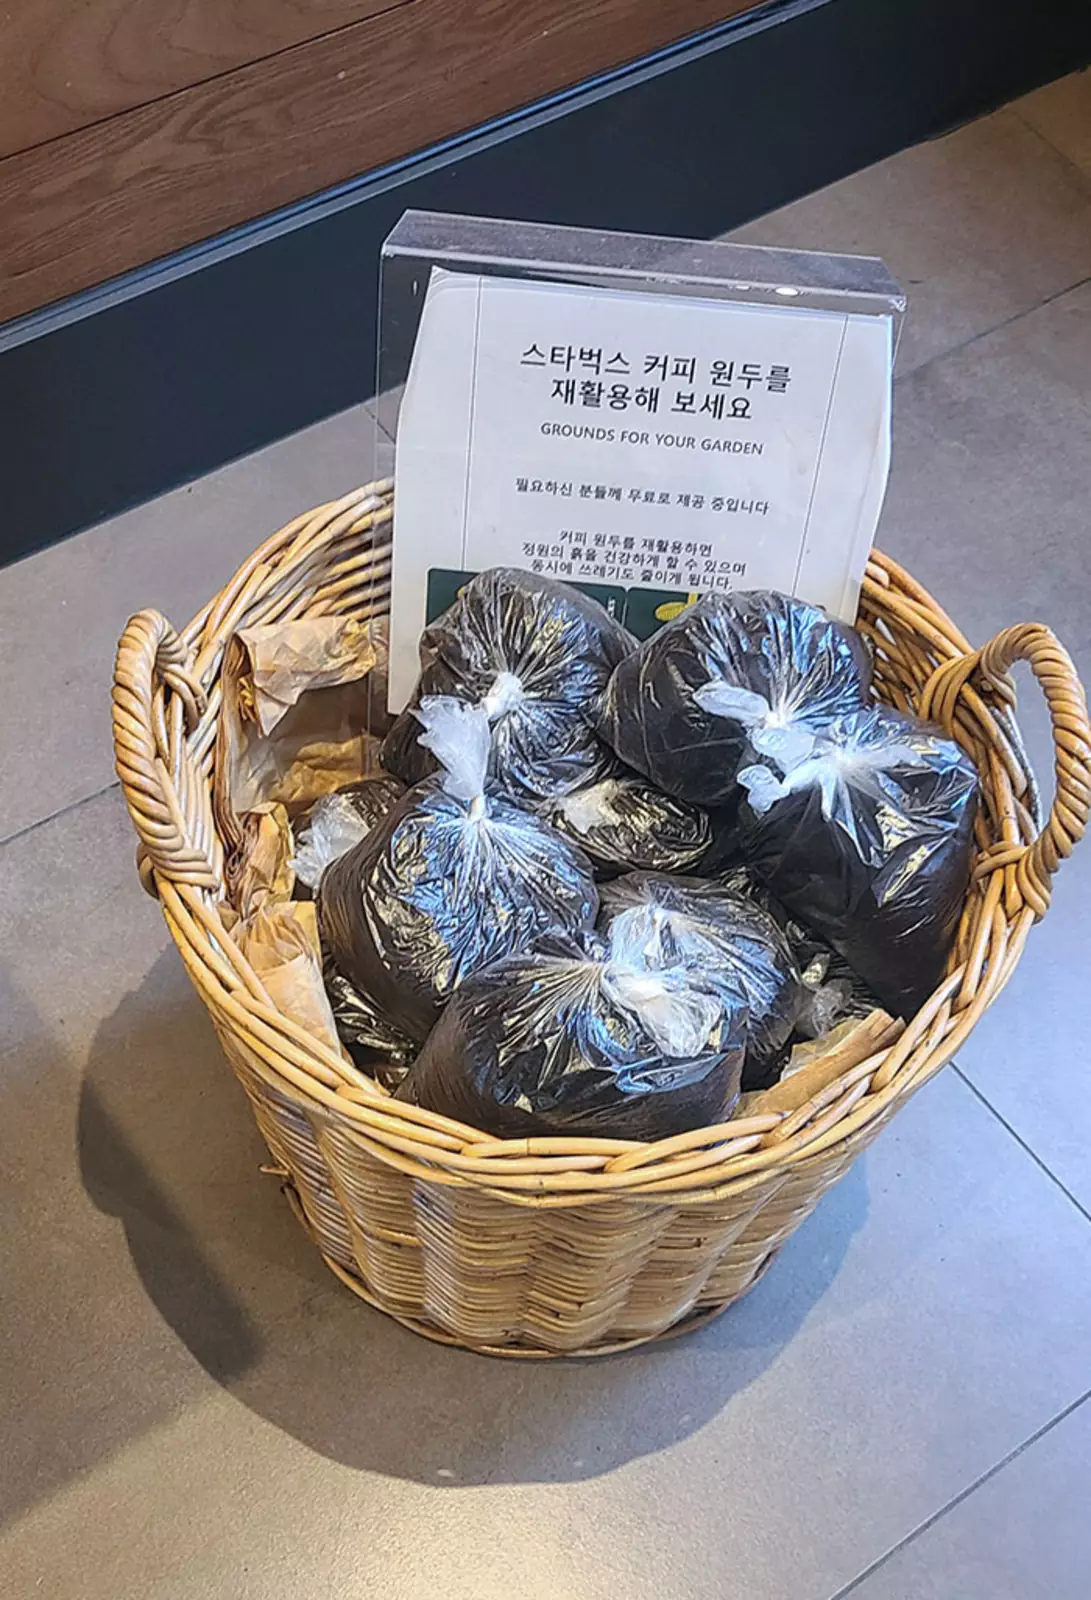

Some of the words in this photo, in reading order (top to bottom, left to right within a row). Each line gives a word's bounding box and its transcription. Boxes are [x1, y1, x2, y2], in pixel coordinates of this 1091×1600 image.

[520, 344, 631, 375] 스타벅스
[643, 353, 696, 384] 커피
[709, 360, 792, 393] 원두를
[551, 379, 660, 413] 재활용해
[671, 392, 752, 420] 보세요
[540, 422, 615, 442] GROUNDS
[620, 430, 650, 446] FOR
[655, 434, 695, 449] YOUR
[701, 438, 764, 455] GARDEN
[515, 478, 573, 497] 필요하신
[579, 484, 622, 501] 분들께
[628, 488, 671, 505] 무료로
[676, 494, 704, 510] 제공
[710, 496, 770, 516] 중입니다
[522, 542, 564, 559] 정원의
[570, 547, 598, 562] 흙을
[604, 549, 659, 568] 건강하게
[666, 555, 679, 569] 할
[684, 558, 698, 571] 수
[704, 560, 747, 576] 있으며
[559, 530, 587, 546] 커피
[593, 533, 636, 551] 원두를
[641, 537, 713, 557] 재활용하면
[531, 559, 573, 575] 동시에
[579, 563, 635, 580] 쓰레기도
[641, 568, 682, 586] 줄이게
